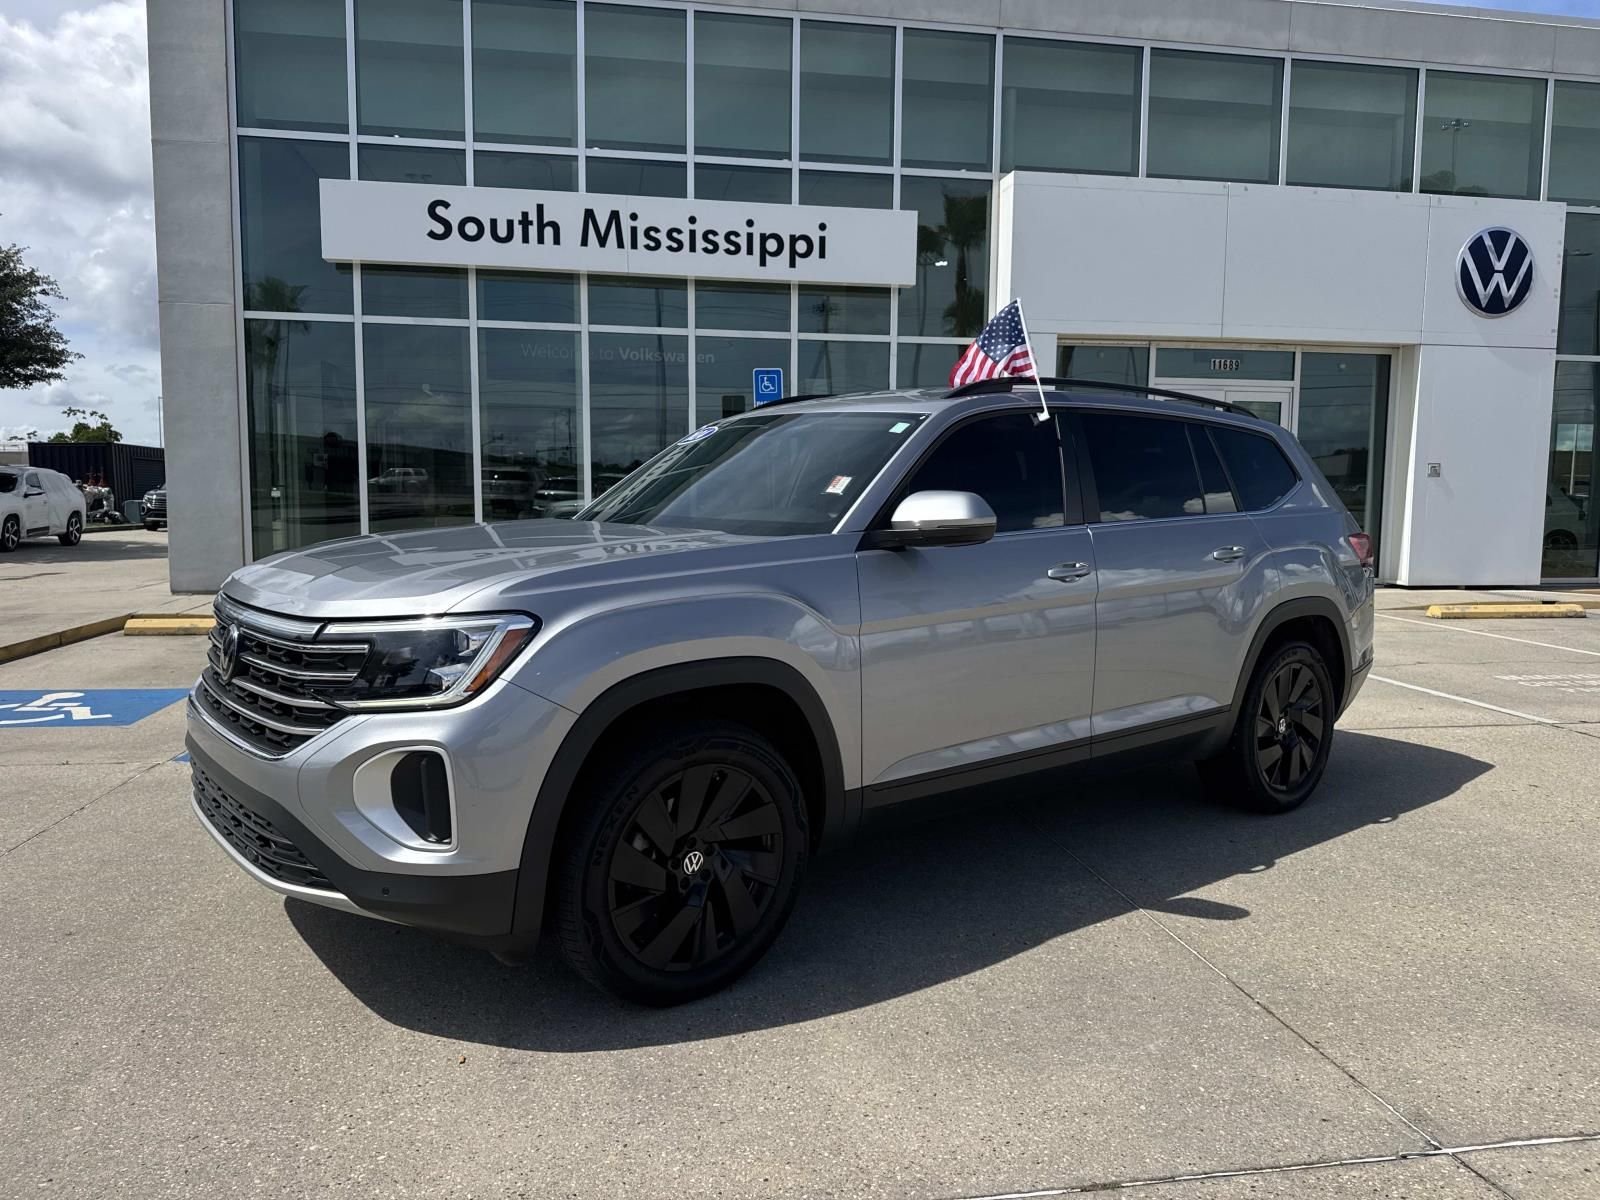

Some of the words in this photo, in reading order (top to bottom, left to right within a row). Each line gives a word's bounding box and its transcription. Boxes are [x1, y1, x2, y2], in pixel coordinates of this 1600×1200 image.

[426, 199, 561, 246] South
[580, 208, 828, 268] Mississippi
[1457, 227, 1534, 315] VW
[520, 343, 593, 361] Welco
[619, 346, 715, 364] Volkswaen
[1211, 359, 1240, 371] 11689
[684, 851, 703, 874] VW
